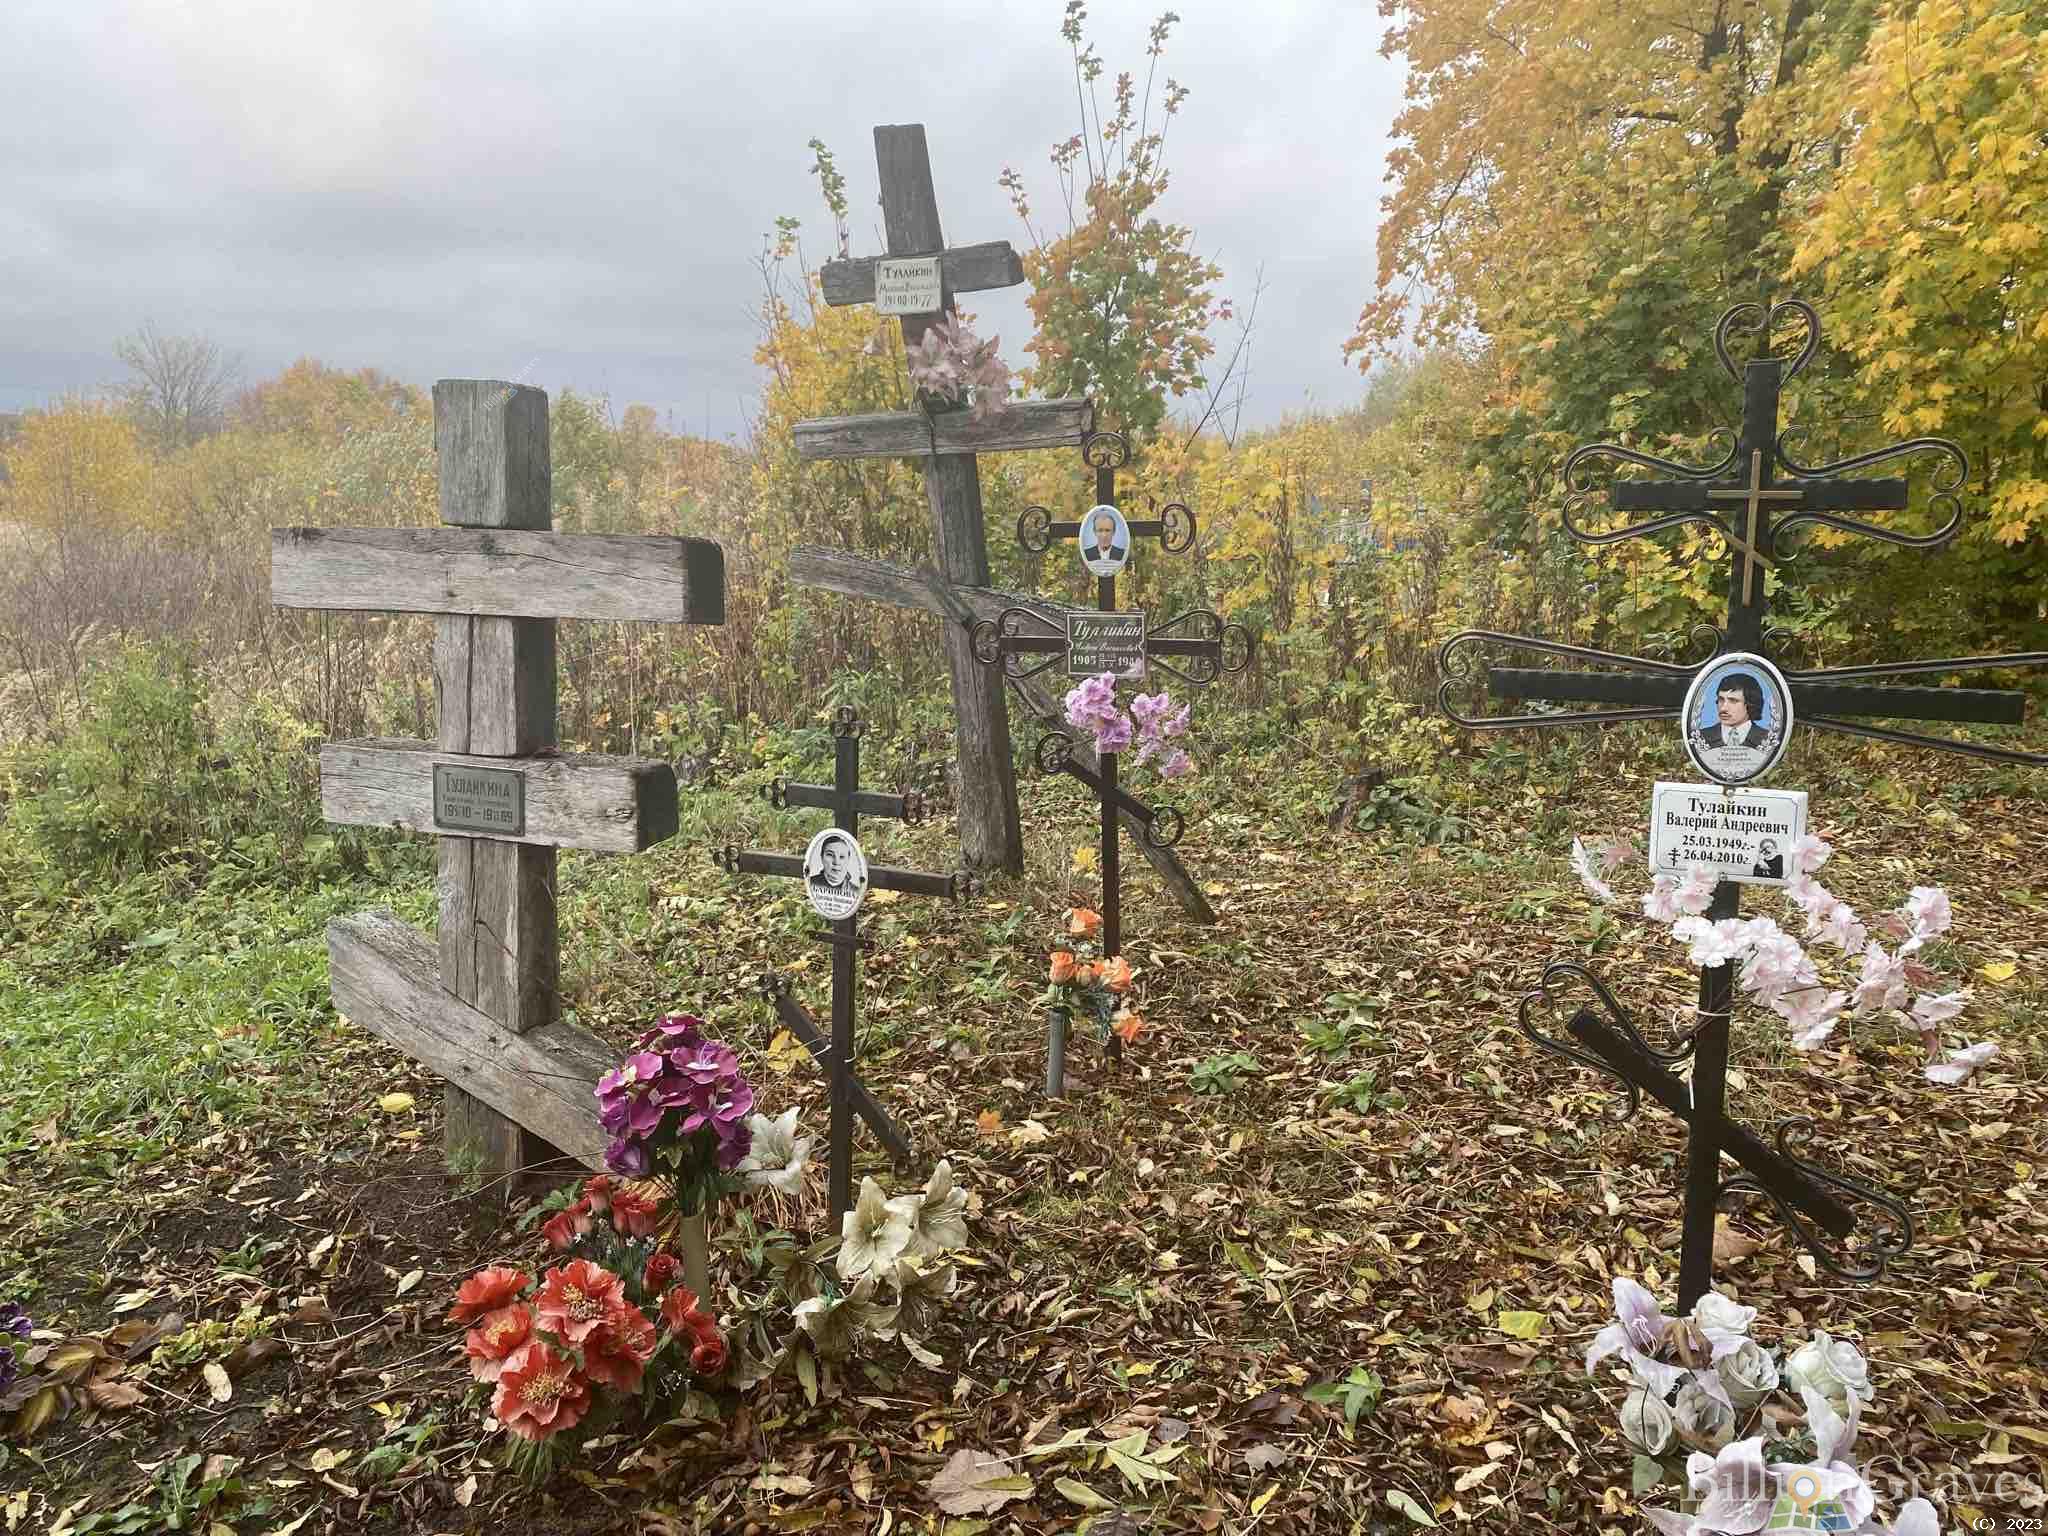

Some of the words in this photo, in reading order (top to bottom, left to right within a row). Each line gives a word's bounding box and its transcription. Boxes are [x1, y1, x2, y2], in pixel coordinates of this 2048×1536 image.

[1688, 798, 1767, 817] Тулайкин
[1666, 811, 1717, 831] Валерий
[1721, 817, 1788, 834] Андреевич
